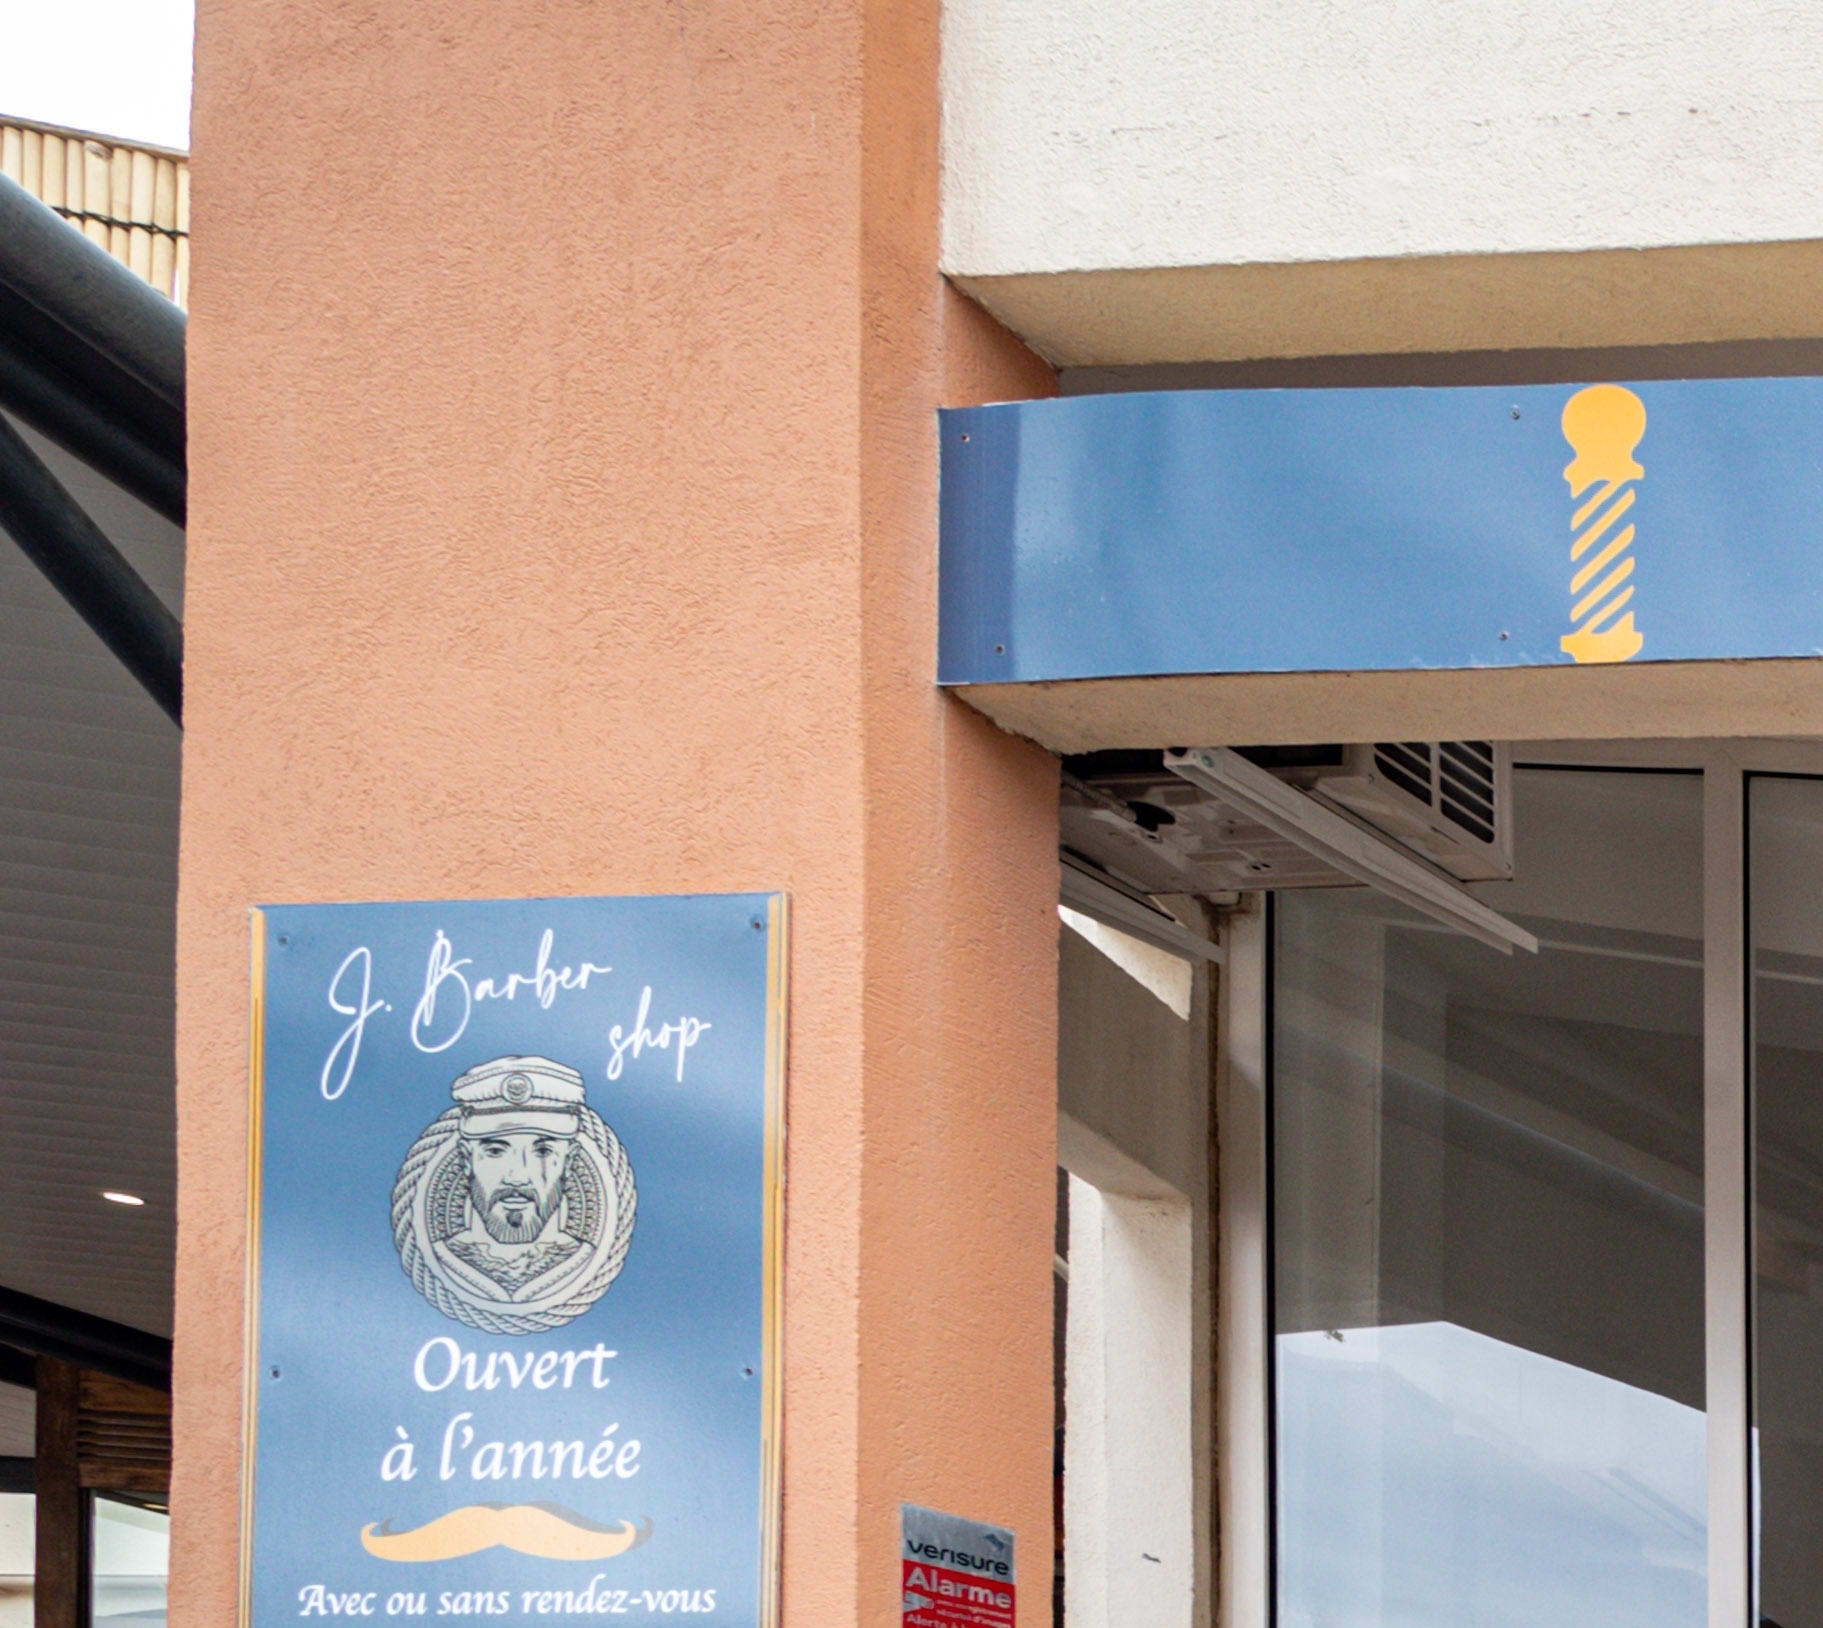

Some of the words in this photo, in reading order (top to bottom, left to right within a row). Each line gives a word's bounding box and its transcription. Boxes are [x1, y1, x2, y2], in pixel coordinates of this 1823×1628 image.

[319, 946, 393, 1101] J.
[411, 929, 613, 1053] Barber
[608, 987, 713, 1083] shop
[413, 1336, 617, 1392] Ouvert
[380, 1426, 418, 1482] à
[439, 1411, 642, 1483] l'année
[907, 1539, 1010, 1577] verisure
[298, 1584, 378, 1617] Avec
[386, 1592, 427, 1616] ou
[437, 1590, 512, 1616] sans
[521, 1574, 718, 1616] rendez-vous
[905, 1566, 1012, 1609] Alarme
